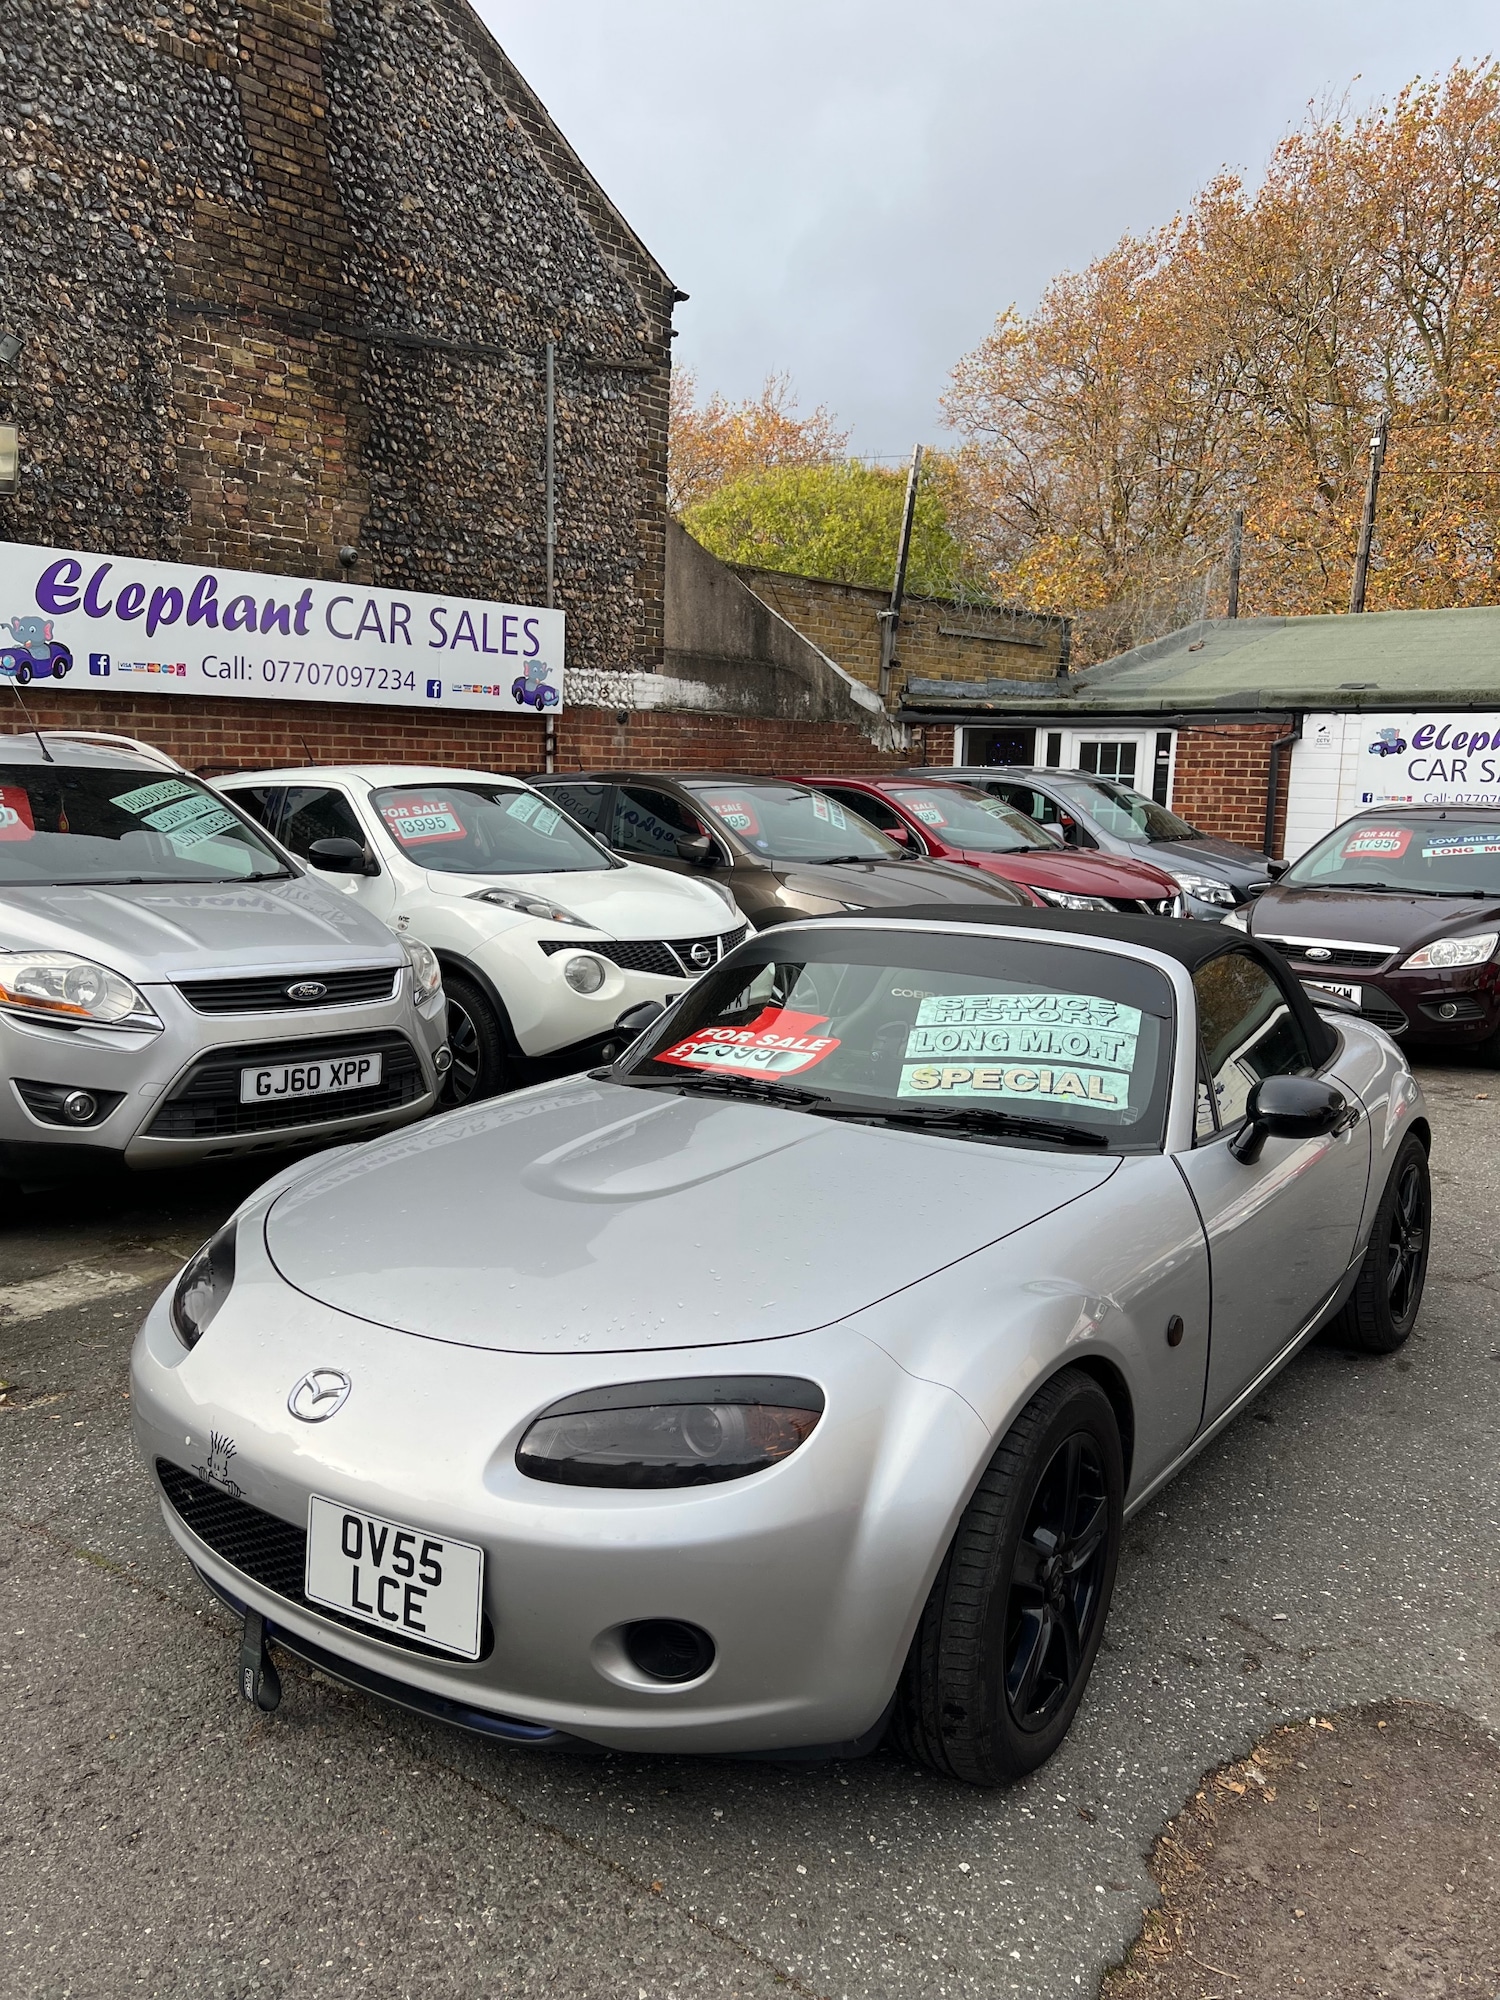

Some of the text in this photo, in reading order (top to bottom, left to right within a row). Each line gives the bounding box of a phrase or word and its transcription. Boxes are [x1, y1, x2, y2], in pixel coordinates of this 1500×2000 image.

[35, 558, 540, 657] Elephant CAR SALES
[201, 655, 416, 691] Call: 07707097234
[1407, 758, 1500, 783] CAR S
[381, 802, 448, 818] FOR SALE
[721, 803, 743, 813] SALE
[913, 801, 936, 811] SALE
[1377, 830, 1401, 838] SALE
[1429, 837, 1459, 845] LOW
[1432, 847, 1475, 856] LONG
[298, 985, 319, 996] Ford
[891, 987, 942, 999] COBR
[936, 996, 1118, 1014] SERVICE
[936, 1009, 1120, 1027] HISTORY
[696, 1028, 832, 1051] FOR SALE
[915, 1029, 1125, 1062] LONG M.O.T
[256, 1066, 321, 1097] GJ60
[329, 1059, 371, 1088] XPP
[909, 1067, 1118, 1103] SPECIAL
[341, 1514, 444, 1588] OV55
[351, 1565, 428, 1634] LCE
